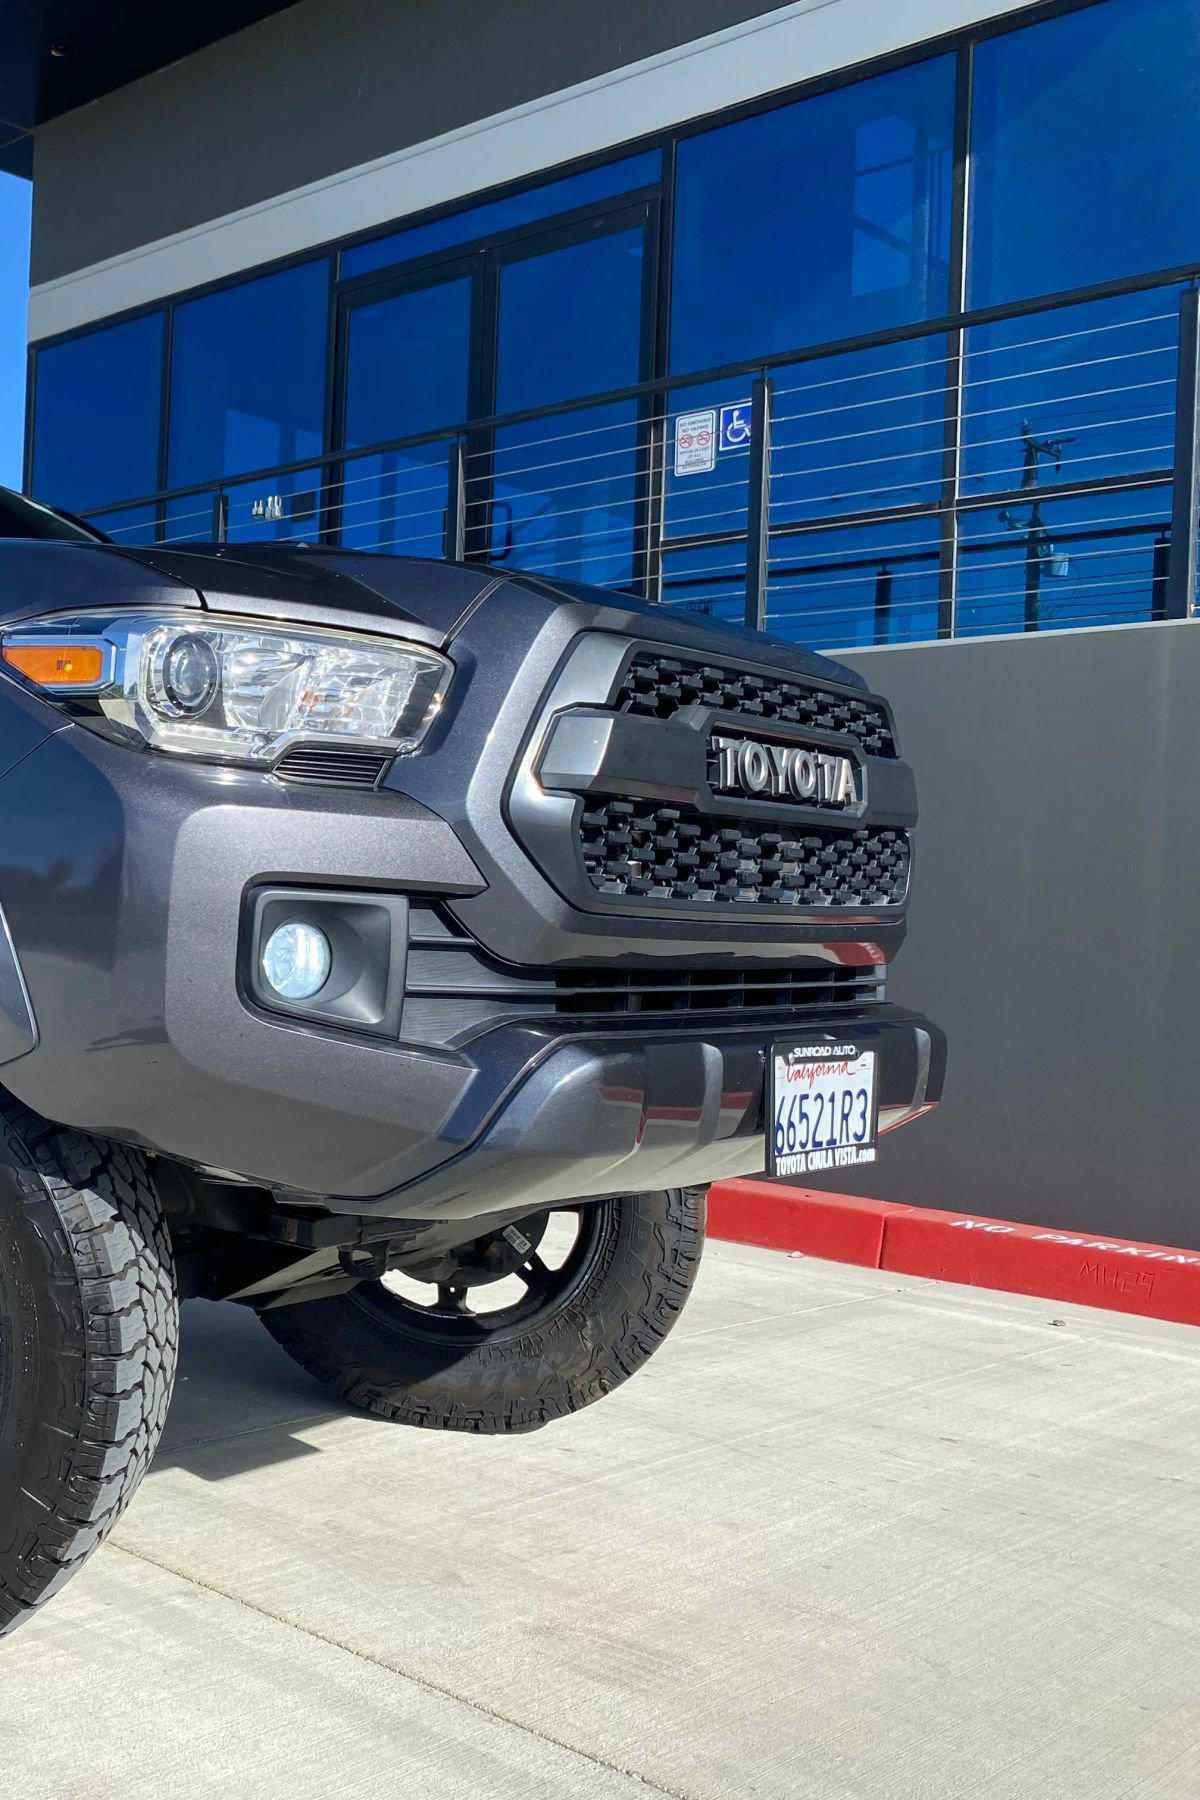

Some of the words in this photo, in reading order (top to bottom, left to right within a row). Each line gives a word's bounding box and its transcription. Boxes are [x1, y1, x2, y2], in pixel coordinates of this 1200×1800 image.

[711, 736, 857, 804] TOYOTA
[794, 1046, 831, 1058] SUNROAD
[832, 1044, 856, 1056] AUTO
[786, 1060, 856, 1089] California
[775, 1088, 868, 1155] 66521R3
[776, 1153, 807, 1176] TOYOTA
[807, 1147, 834, 1168] CHULA
[834, 1145, 875, 1166] VISTA.com
[950, 1220, 1015, 1233] NO
[1032, 1234, 1200, 1267] PARKIN
